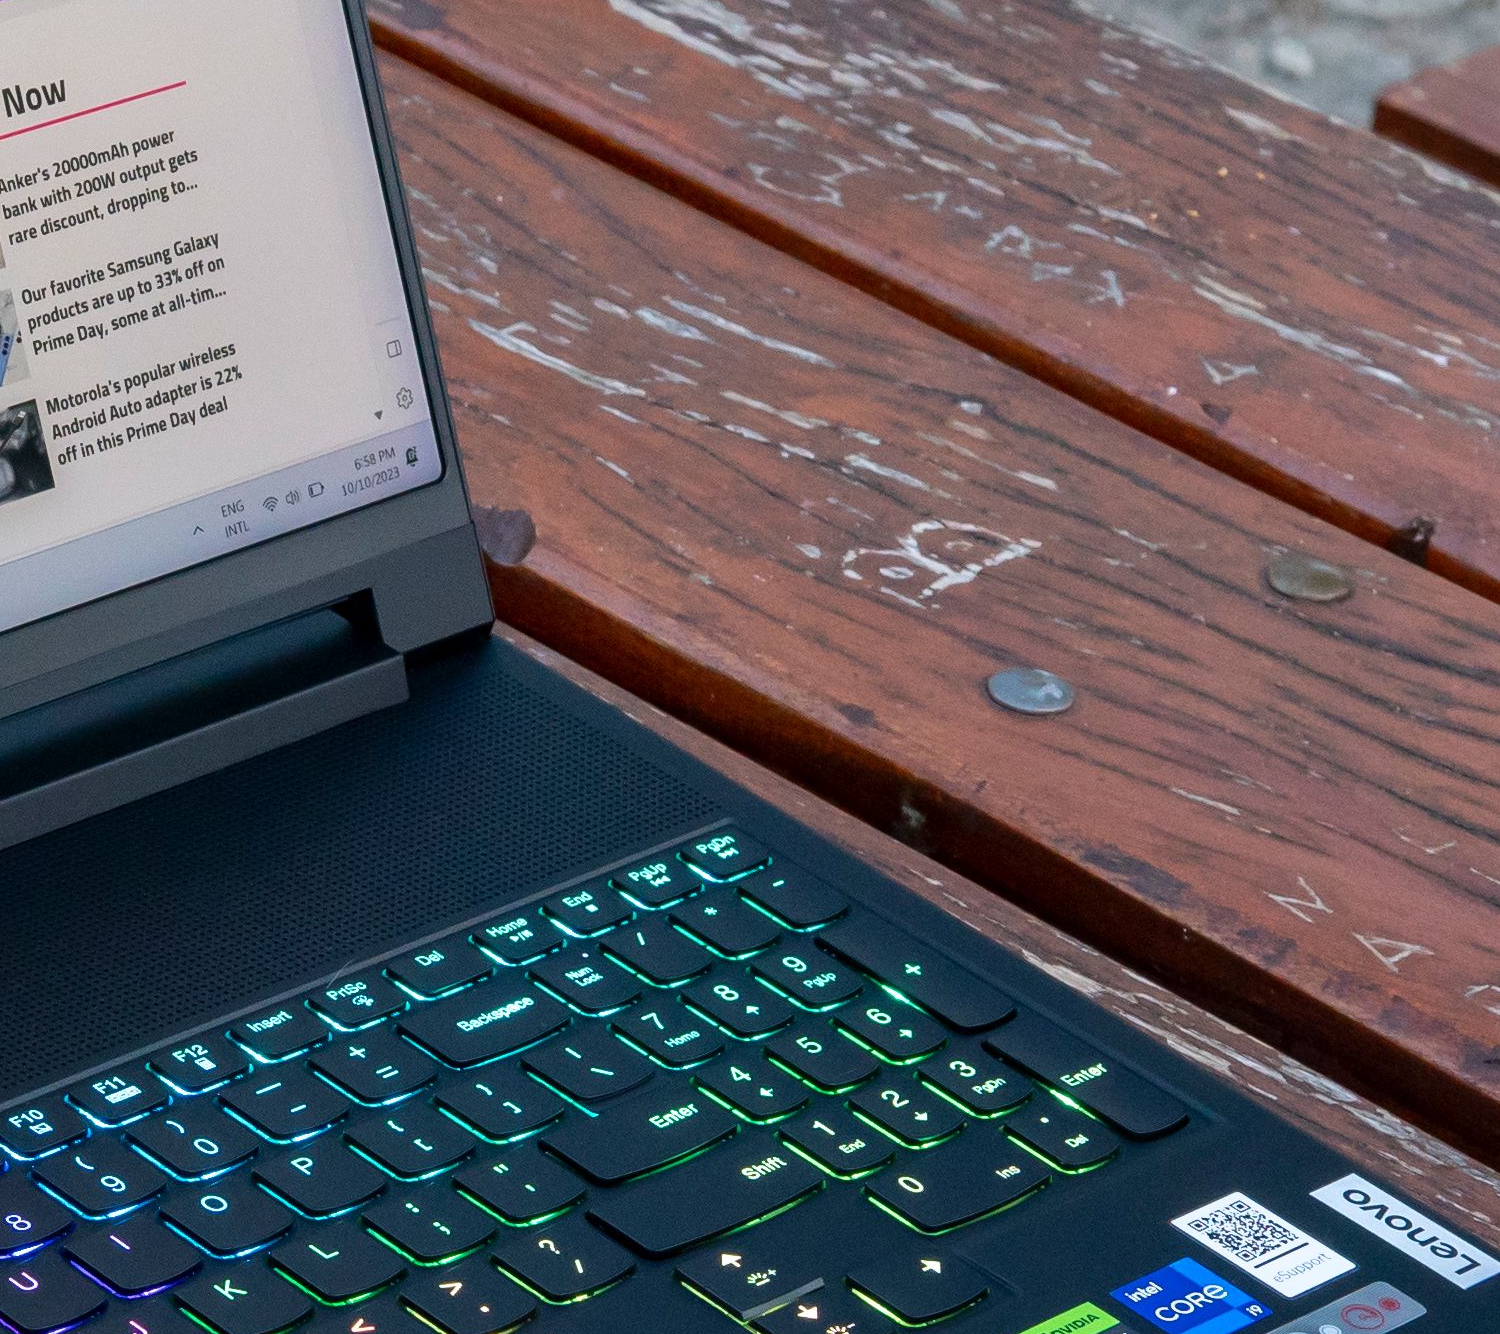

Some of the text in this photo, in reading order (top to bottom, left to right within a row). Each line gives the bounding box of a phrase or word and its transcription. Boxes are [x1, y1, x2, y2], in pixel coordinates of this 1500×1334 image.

[1, 79, 66, 118] Now
[353, 445, 396, 471] 6:58 PM
[341, 465, 401, 497] 10/10/2023
[220, 498, 245, 518] ENG
[224, 520, 250, 539] INTL
[695, 835, 736, 854] PgDn
[627, 862, 667, 881] PgUp
[562, 891, 593, 908] End
[486, 918, 528, 937] Home
[415, 950, 445, 967] Del
[565, 966, 593, 980] Num
[574, 972, 604, 987] Lock
[326, 980, 367, 1001] PrtSc
[246, 1010, 293, 1033] Insert
[456, 996, 535, 1033] Backspace
[172, 1043, 208, 1064] F12
[1060, 1061, 1108, 1088] Enter
[92, 1076, 126, 1096] F11
[9, 1109, 44, 1129] F10
[649, 1102, 698, 1129] Enter
[741, 1155, 787, 1181] Shift
[1342, 1189, 1482, 1275] Lenovo
[1273, 1253, 1332, 1283] eSupport
[1124, 1282, 1164, 1302] intel
[1246, 1304, 1264, 1316] i9
